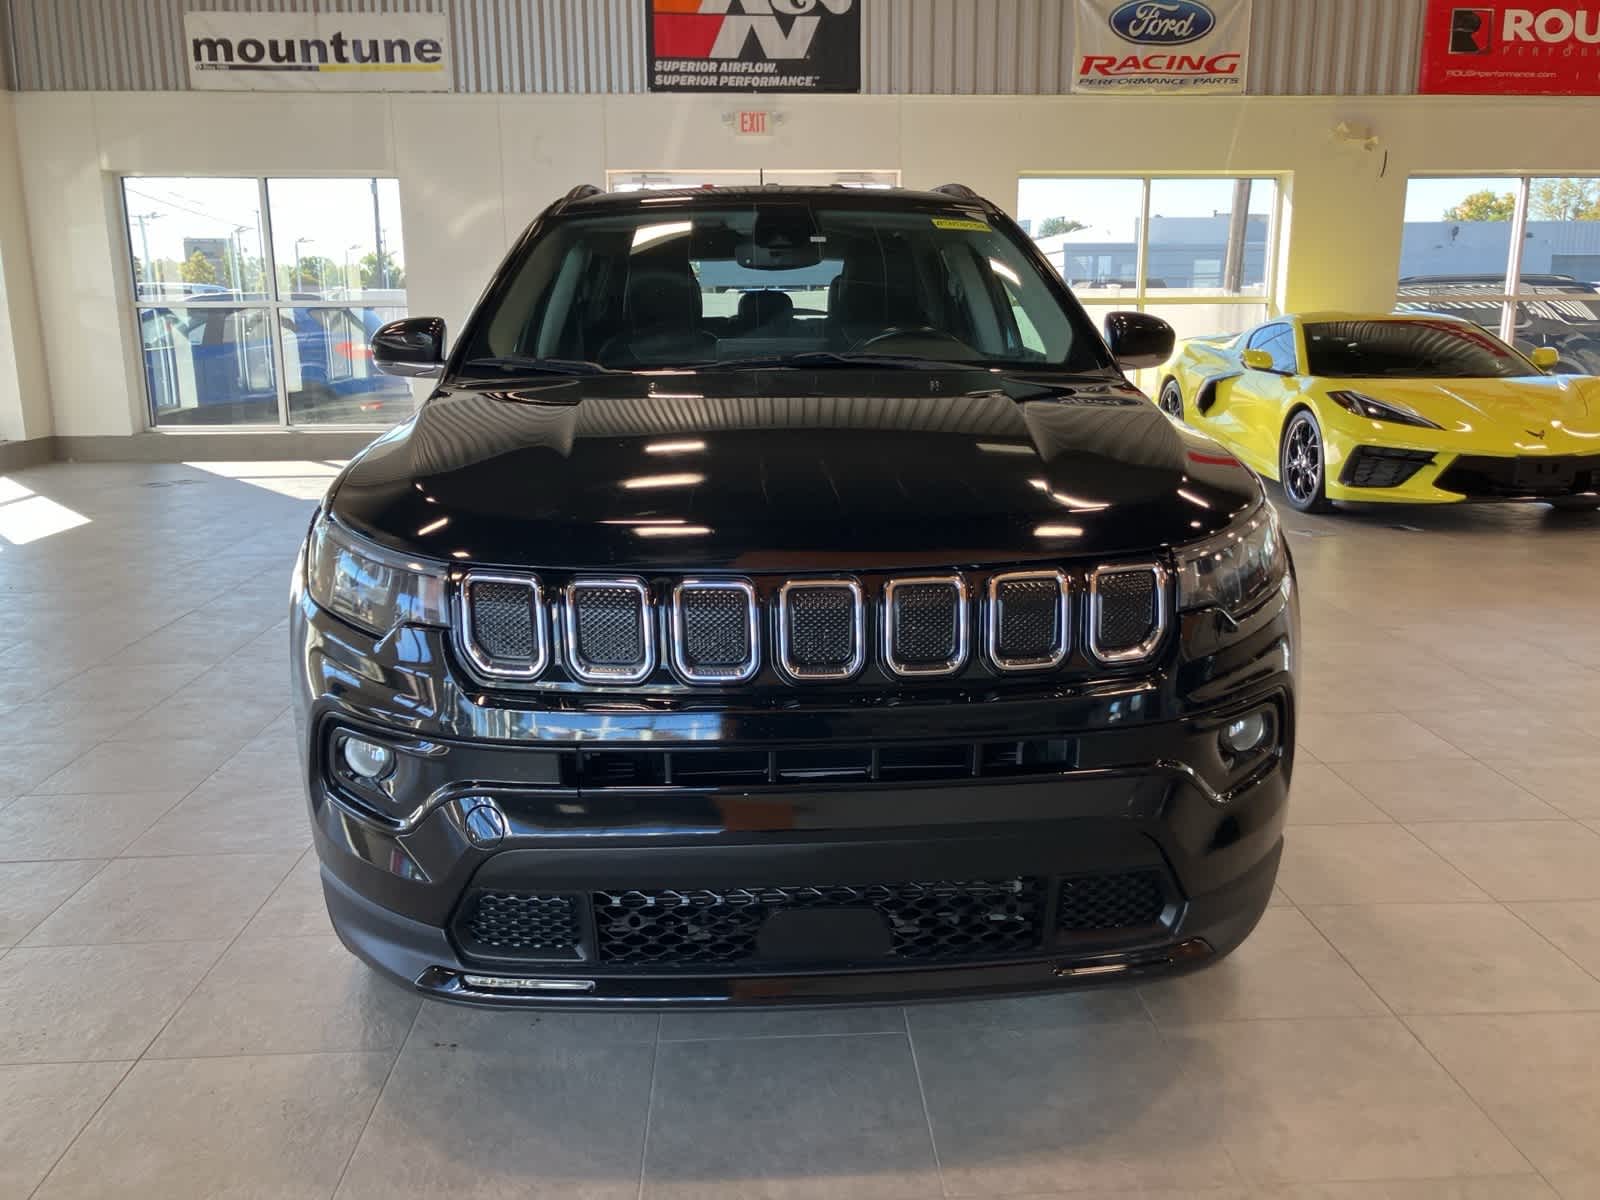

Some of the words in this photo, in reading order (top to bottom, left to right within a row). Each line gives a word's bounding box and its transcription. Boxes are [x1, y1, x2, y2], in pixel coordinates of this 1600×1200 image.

[1128, 3, 1197, 37] Ford
[192, 31, 442, 63] mountune
[654, 61, 718, 73] SUPERIOR
[719, 62, 778, 74] AIRFLOW.
[1079, 54, 1240, 76] RACING
[654, 75, 718, 87] SUPERIOR
[1079, 77, 1189, 87] PERFORMANCE
[1192, 77, 1240, 86] PARTS
[740, 111, 767, 133] EXIT
